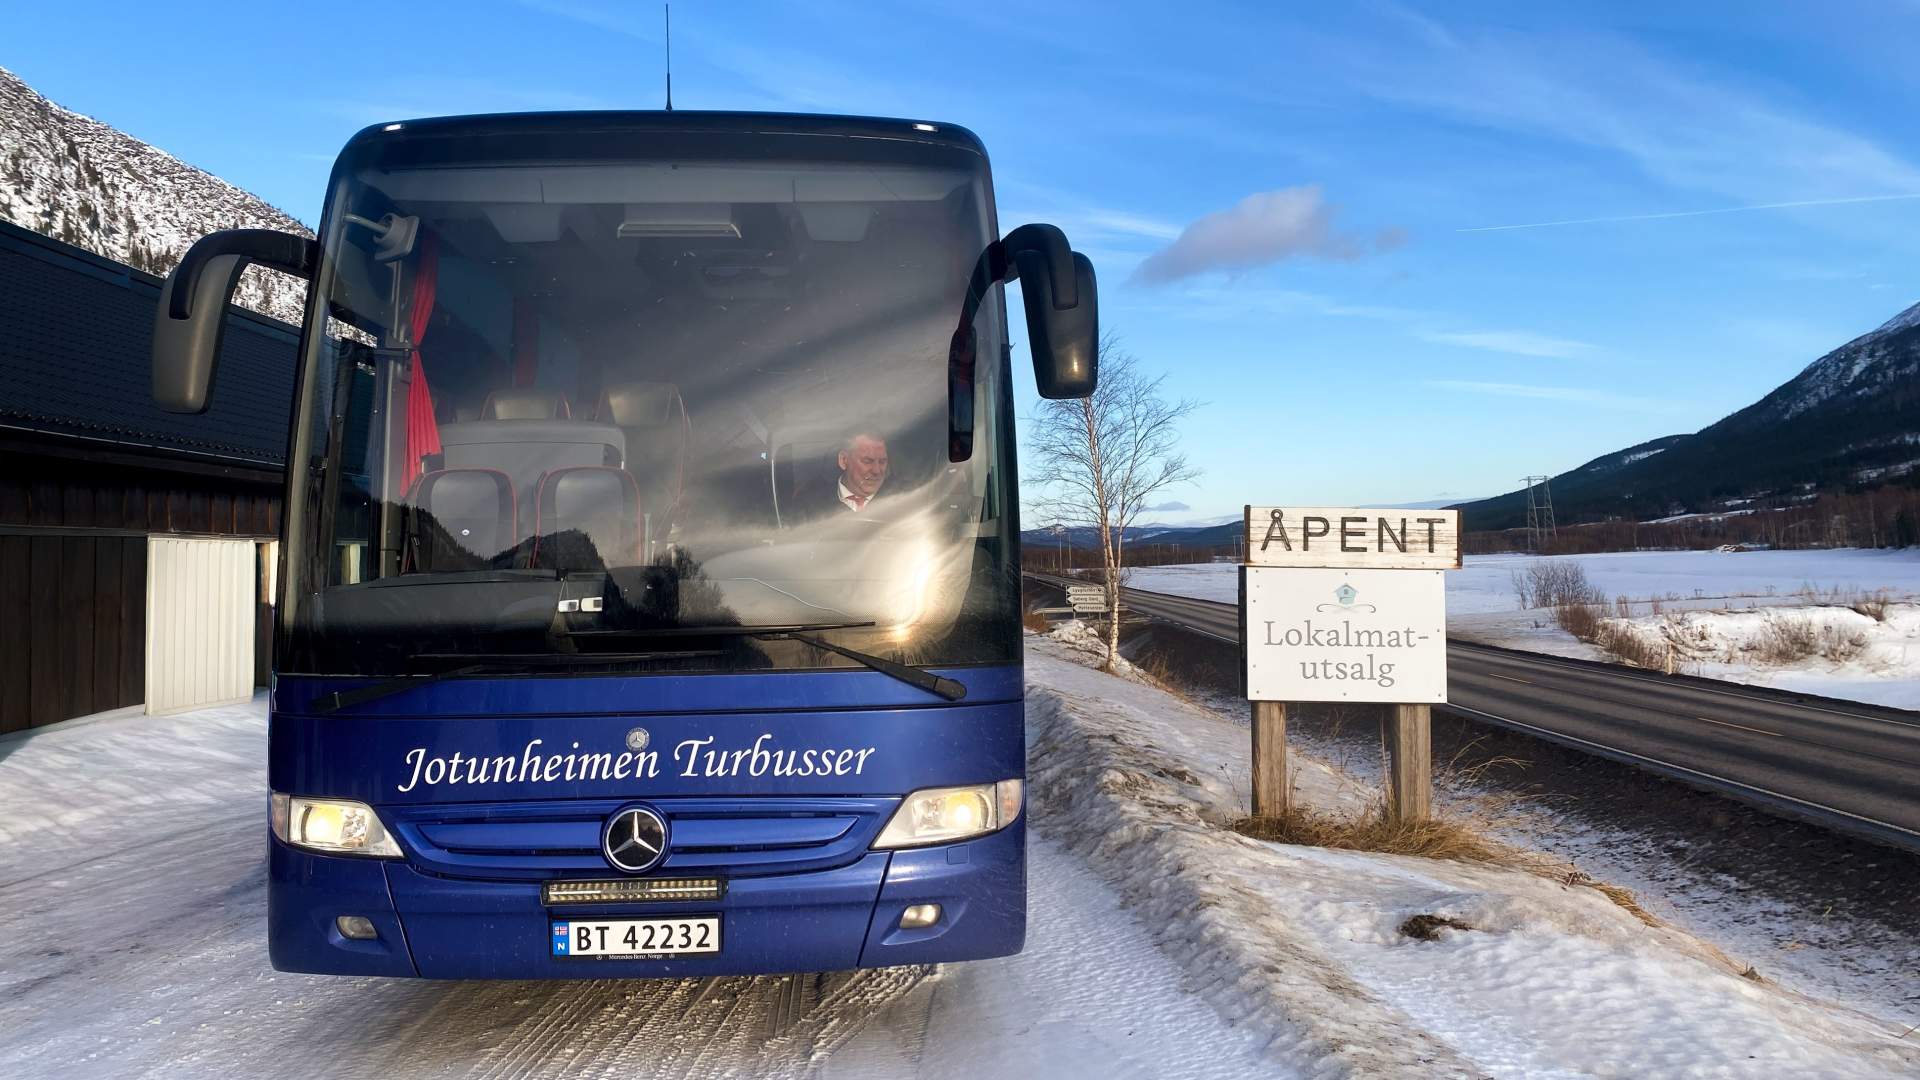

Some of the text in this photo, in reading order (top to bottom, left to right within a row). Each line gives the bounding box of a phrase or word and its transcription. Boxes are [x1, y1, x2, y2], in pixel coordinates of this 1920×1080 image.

[1260, 508, 1446, 554] ÅPENT
[1263, 619, 1429, 648] Lokalmat-
[1299, 653, 1396, 688] utsalg
[397, 738, 660, 792] Jotunheimen
[673, 733, 876, 777] Turbusser
[557, 942, 566, 951] N
[576, 923, 711, 951] BT 42232
